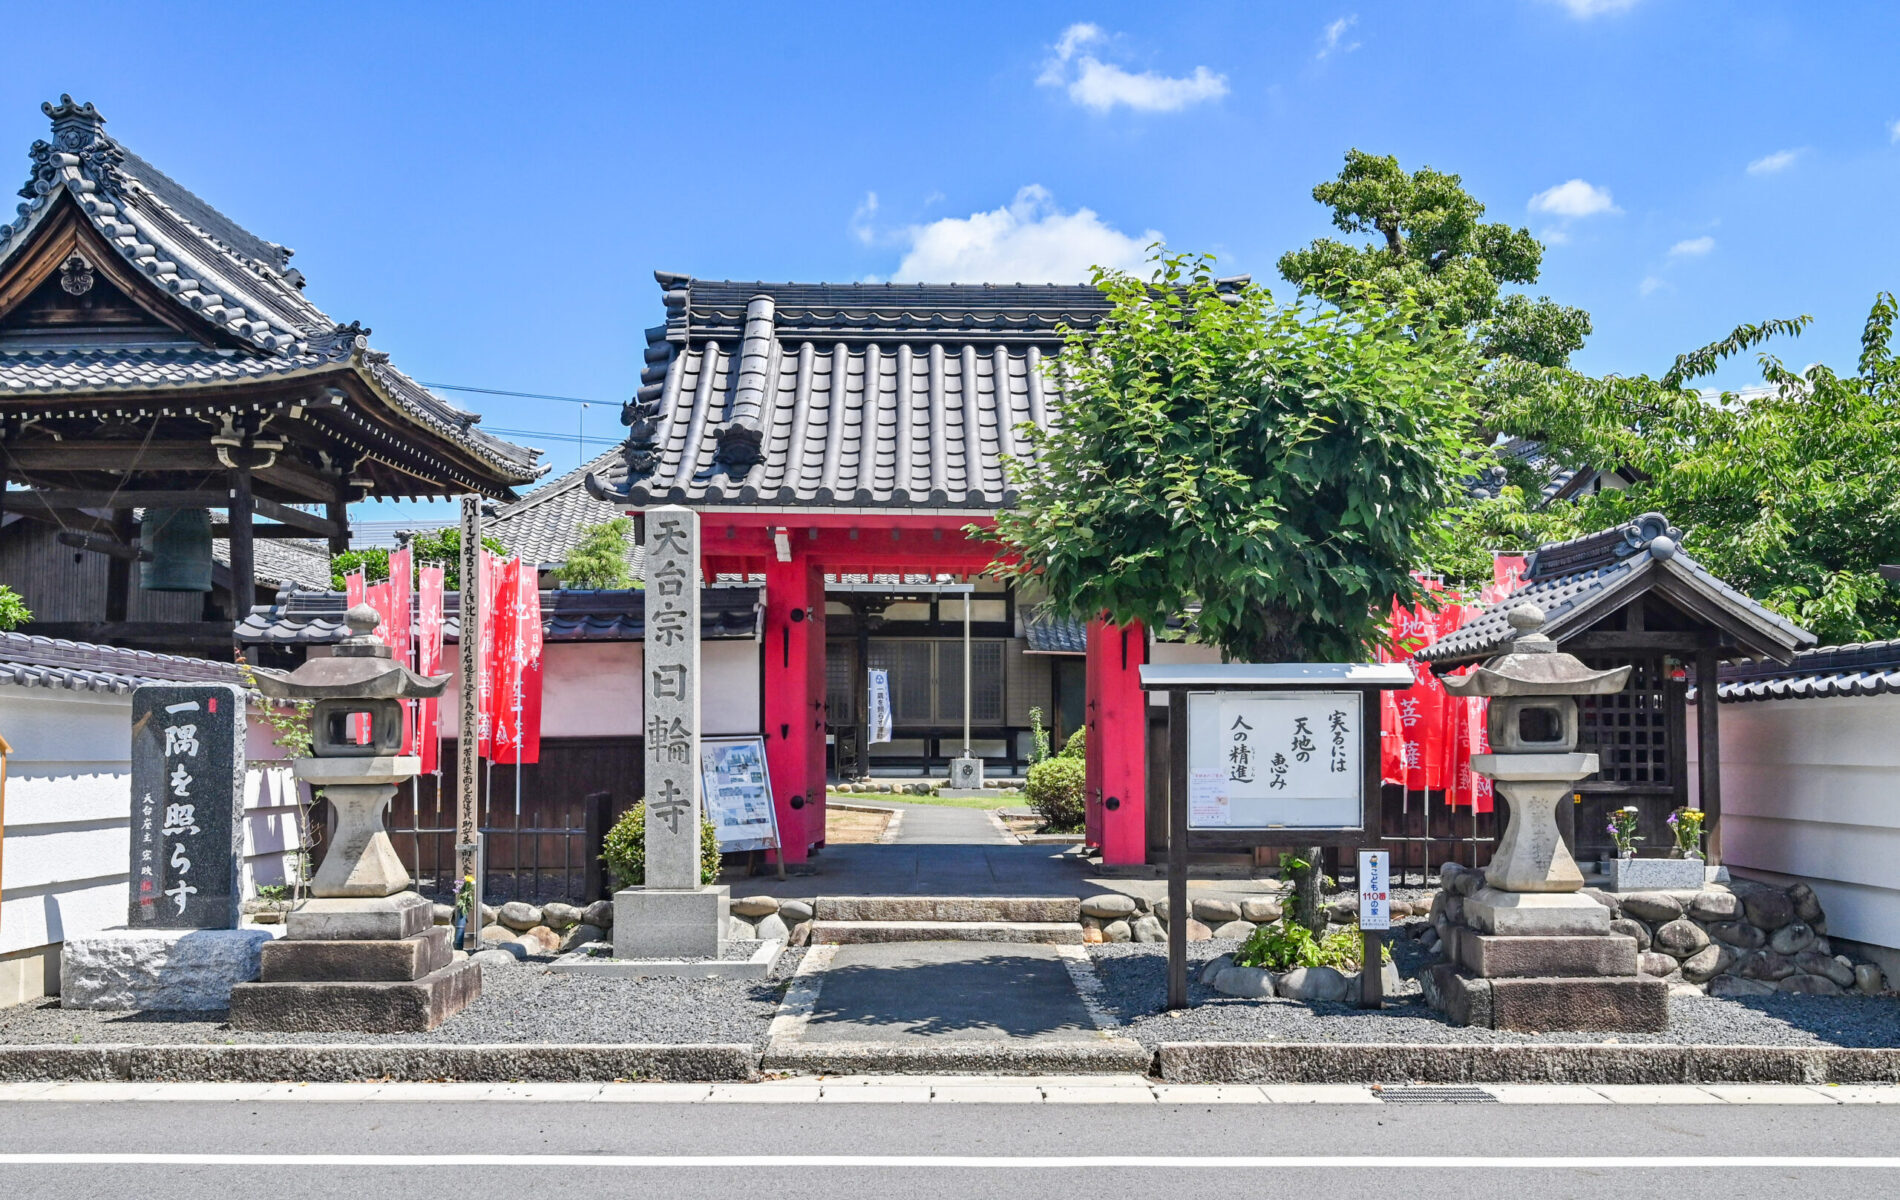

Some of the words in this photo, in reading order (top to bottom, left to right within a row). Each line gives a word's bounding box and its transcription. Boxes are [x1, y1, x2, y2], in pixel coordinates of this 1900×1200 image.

[648, 519, 692, 834] 天台宗日輪寺
[1229, 714, 1254, 784] 人の精進
[1291, 716, 1316, 763] 天地の
[1328, 710, 1350, 773] 実るには
[1269, 752, 1289, 791] 恵み
[162, 701, 200, 917] 一隅を照らす
[1362, 892, 1387, 901] 110番
[1370, 868, 1379, 892] こども
